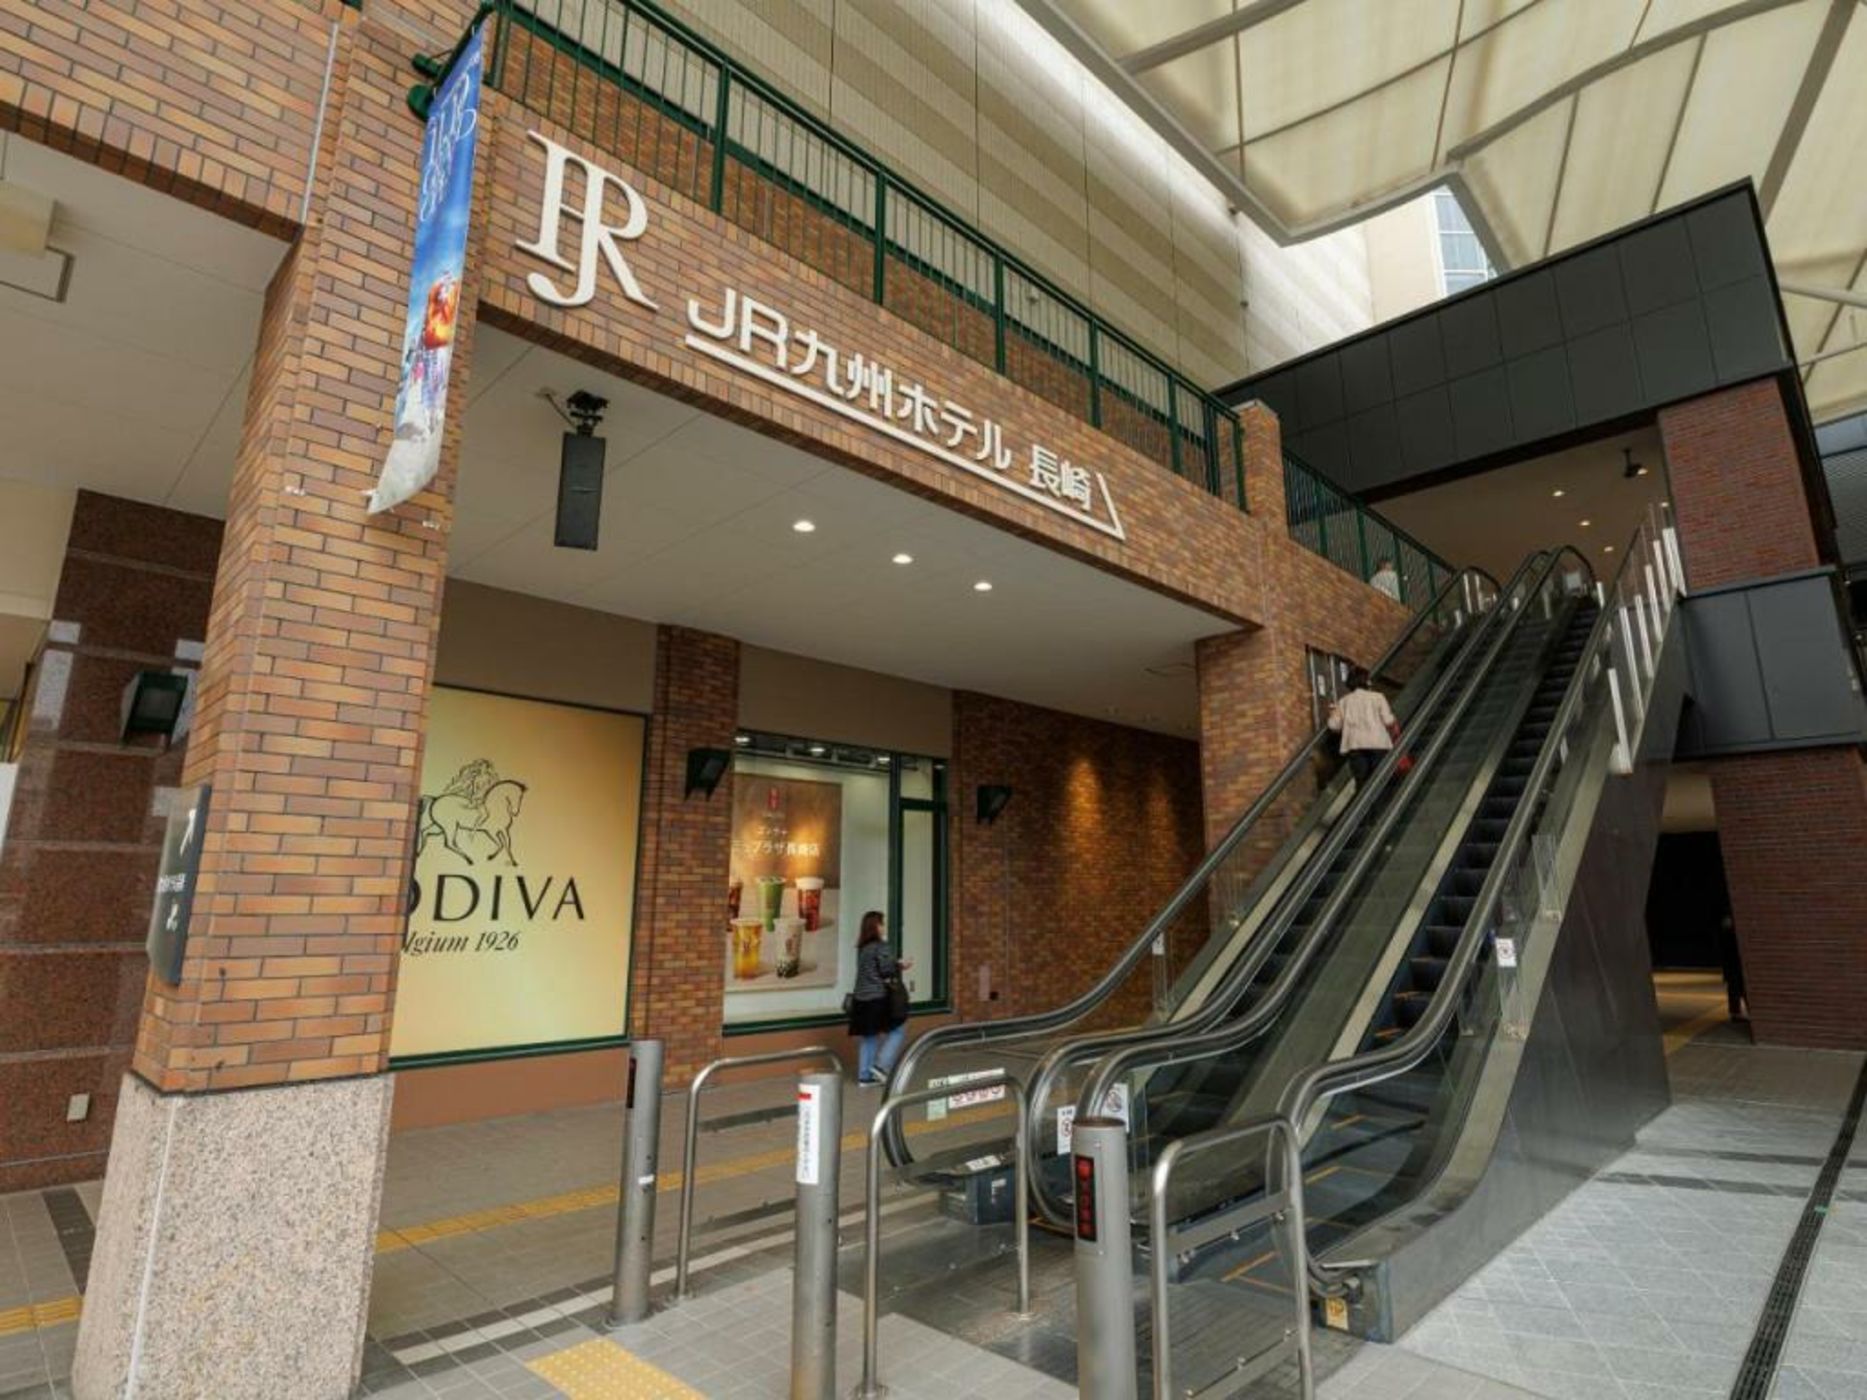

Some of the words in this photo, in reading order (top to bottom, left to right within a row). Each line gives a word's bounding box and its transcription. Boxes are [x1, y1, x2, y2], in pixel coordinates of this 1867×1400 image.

[687, 287, 1012, 470] JR九州ホテル
[1029, 443, 1091, 511] 長崎
[474, 930, 521, 952] 1926
